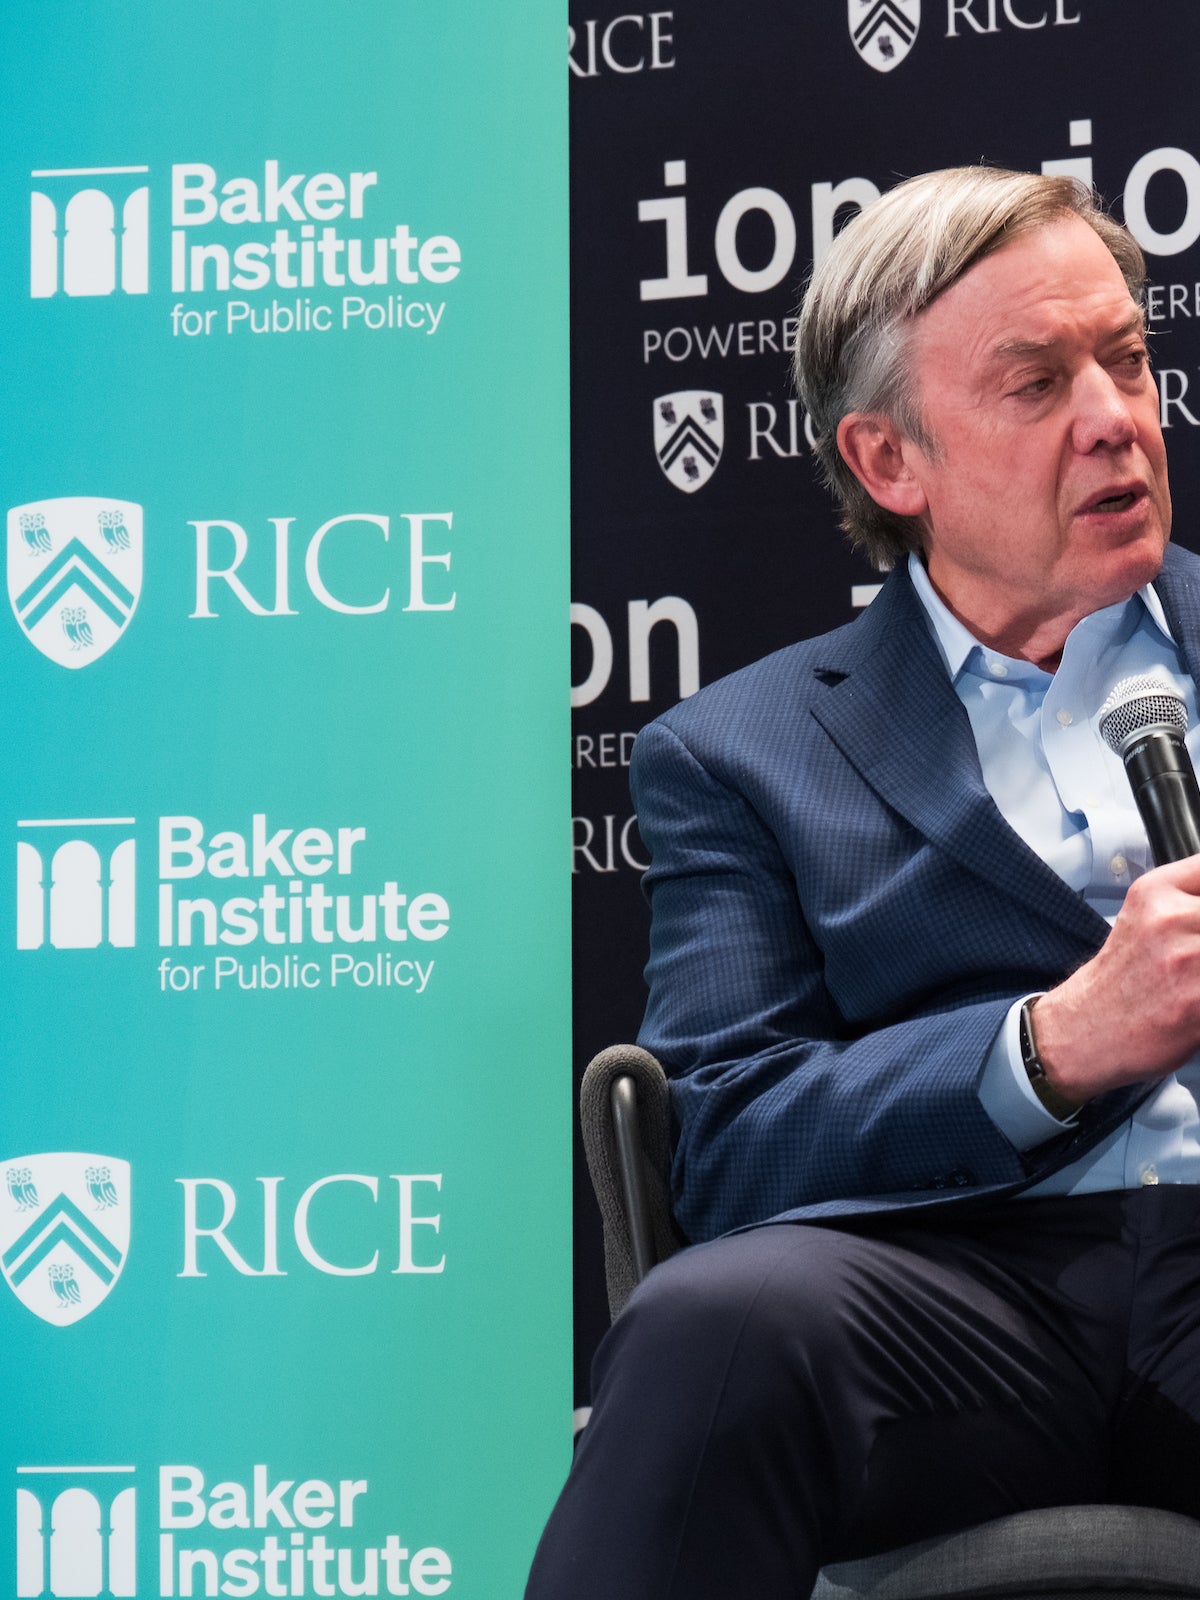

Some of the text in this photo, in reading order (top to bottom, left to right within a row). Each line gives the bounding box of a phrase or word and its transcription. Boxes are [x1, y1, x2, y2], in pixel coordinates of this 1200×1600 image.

[172, 160, 377, 226] Baker
[171, 225, 461, 293] Institute
[171, 295, 445, 336] for Public Policy
[643, 317, 801, 364] POWERE
[187, 512, 456, 618] RICE
[159, 814, 366, 876] Baker
[158, 880, 451, 946] Institute
[158, 953, 434, 993] for Public Policy
[175, 1173, 445, 1277] RICE
[159, 1464, 367, 1527] Baker
[160, 1532, 452, 1597] Institute
